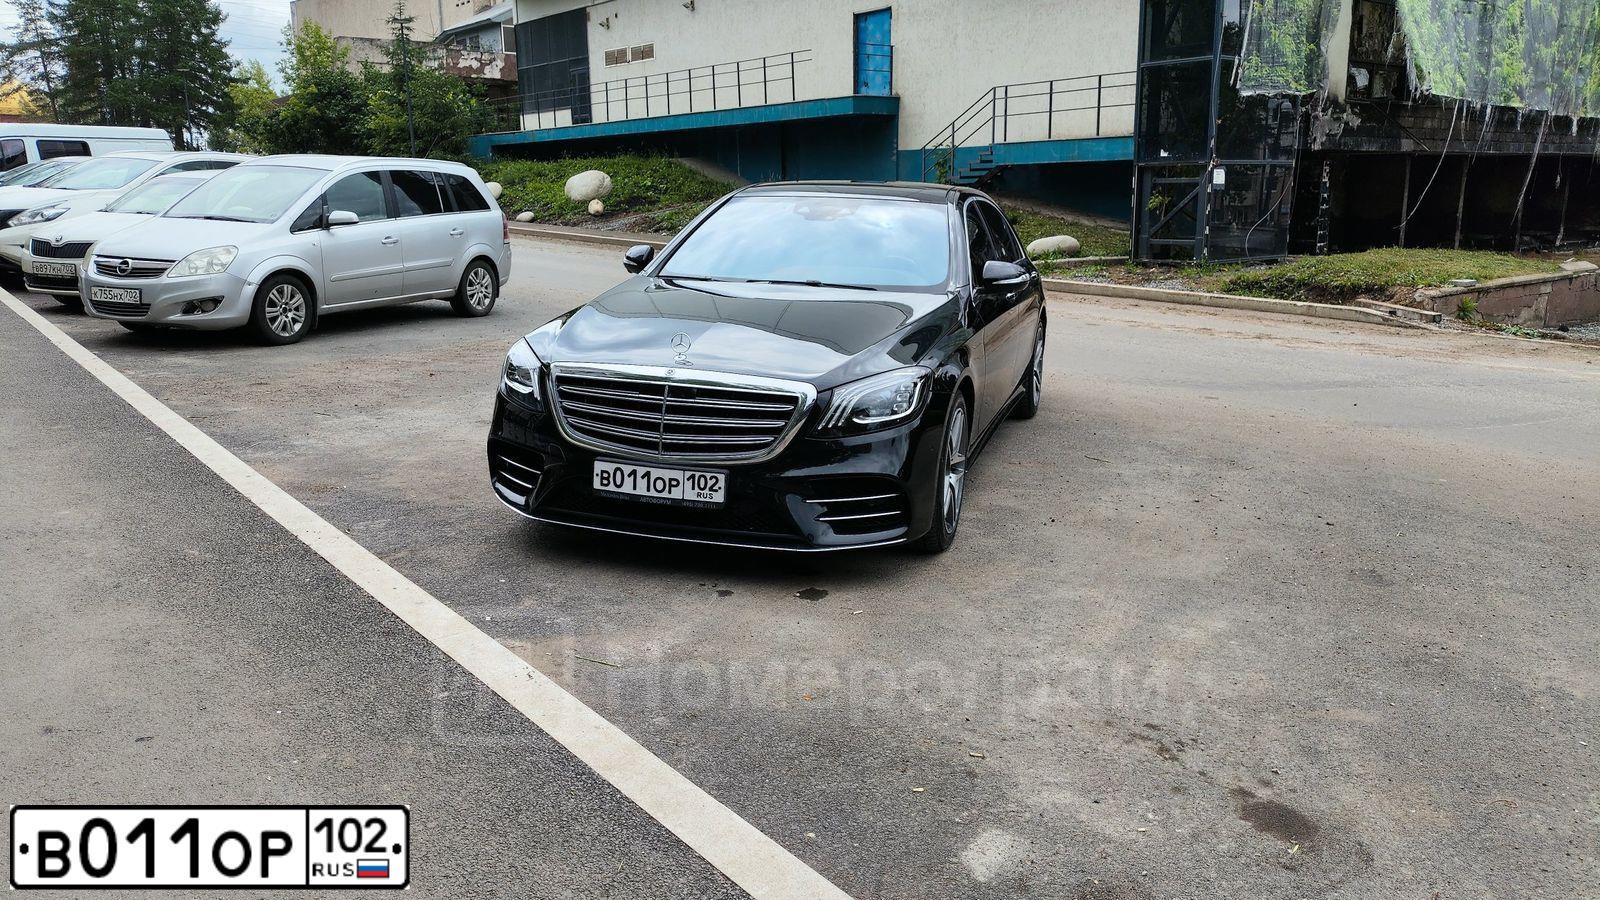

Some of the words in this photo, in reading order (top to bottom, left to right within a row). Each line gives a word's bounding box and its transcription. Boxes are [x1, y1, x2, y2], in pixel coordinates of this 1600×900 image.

[93, 288, 124, 302] К755НХ
[124, 289, 138, 300] 702
[599, 466, 681, 495] В011ОР
[686, 473, 720, 493] 102
[696, 491, 714, 500] RUS
